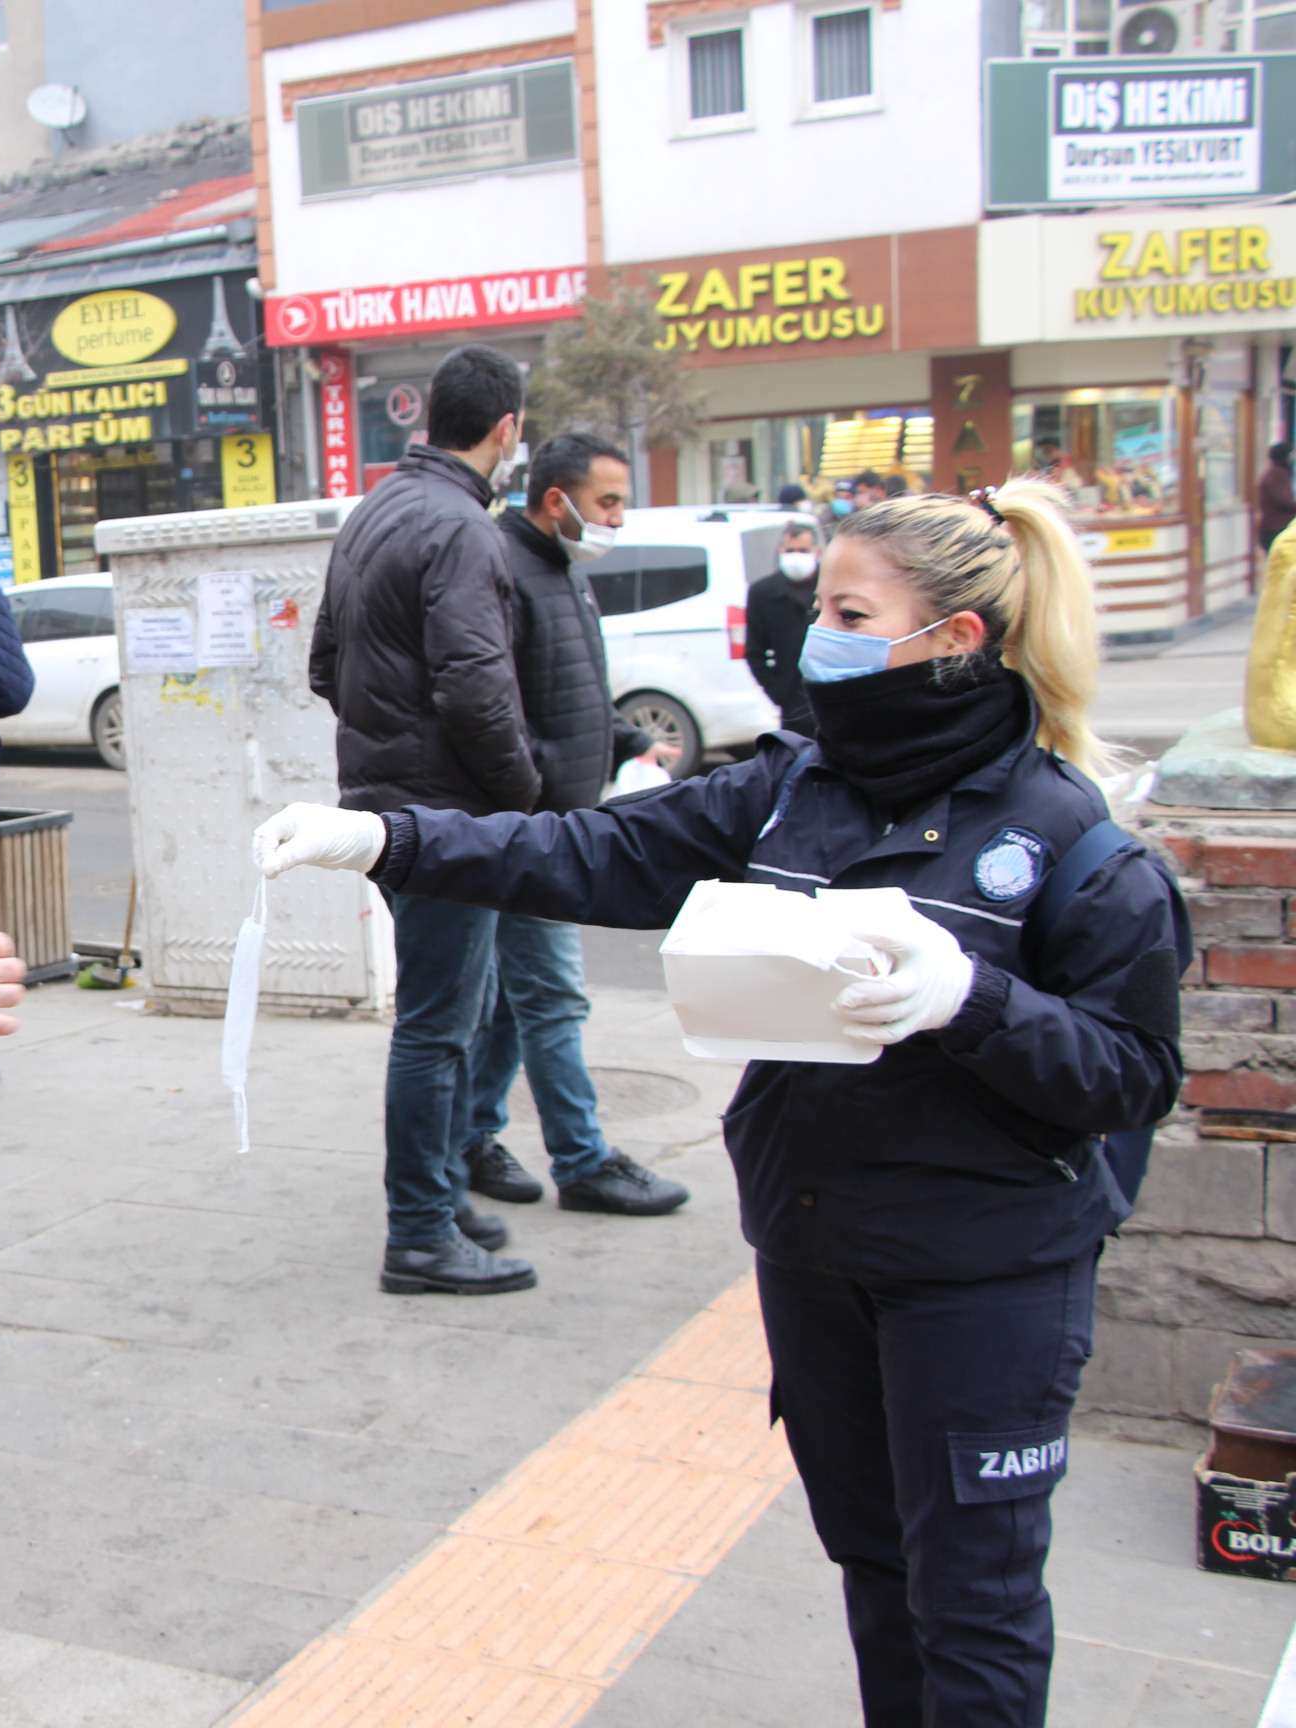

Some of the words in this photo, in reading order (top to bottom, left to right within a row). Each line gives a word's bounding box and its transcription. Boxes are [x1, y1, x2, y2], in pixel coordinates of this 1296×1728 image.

[1065, 143, 1135, 167] Dursun
[1098, 225, 1271, 281] ZAFER
[321, 288, 396, 331] TÜRK
[401, 281, 478, 323] HAVA
[654, 256, 851, 318] ZAFER
[1075, 278, 1296, 322] KUYUMCUSU
[80, 297, 146, 326] EYFEL
[653, 304, 885, 351] UYUMCUSU
[77, 324, 154, 354] perfume
[17, 387, 72, 420] GÜN
[71, 381, 168, 415] KALICI
[235, 438, 256, 468] 3
[12, 459, 29, 488] 3
[328, 455, 349, 498] HAV
[1003, 831, 1042, 854] ZABITA
